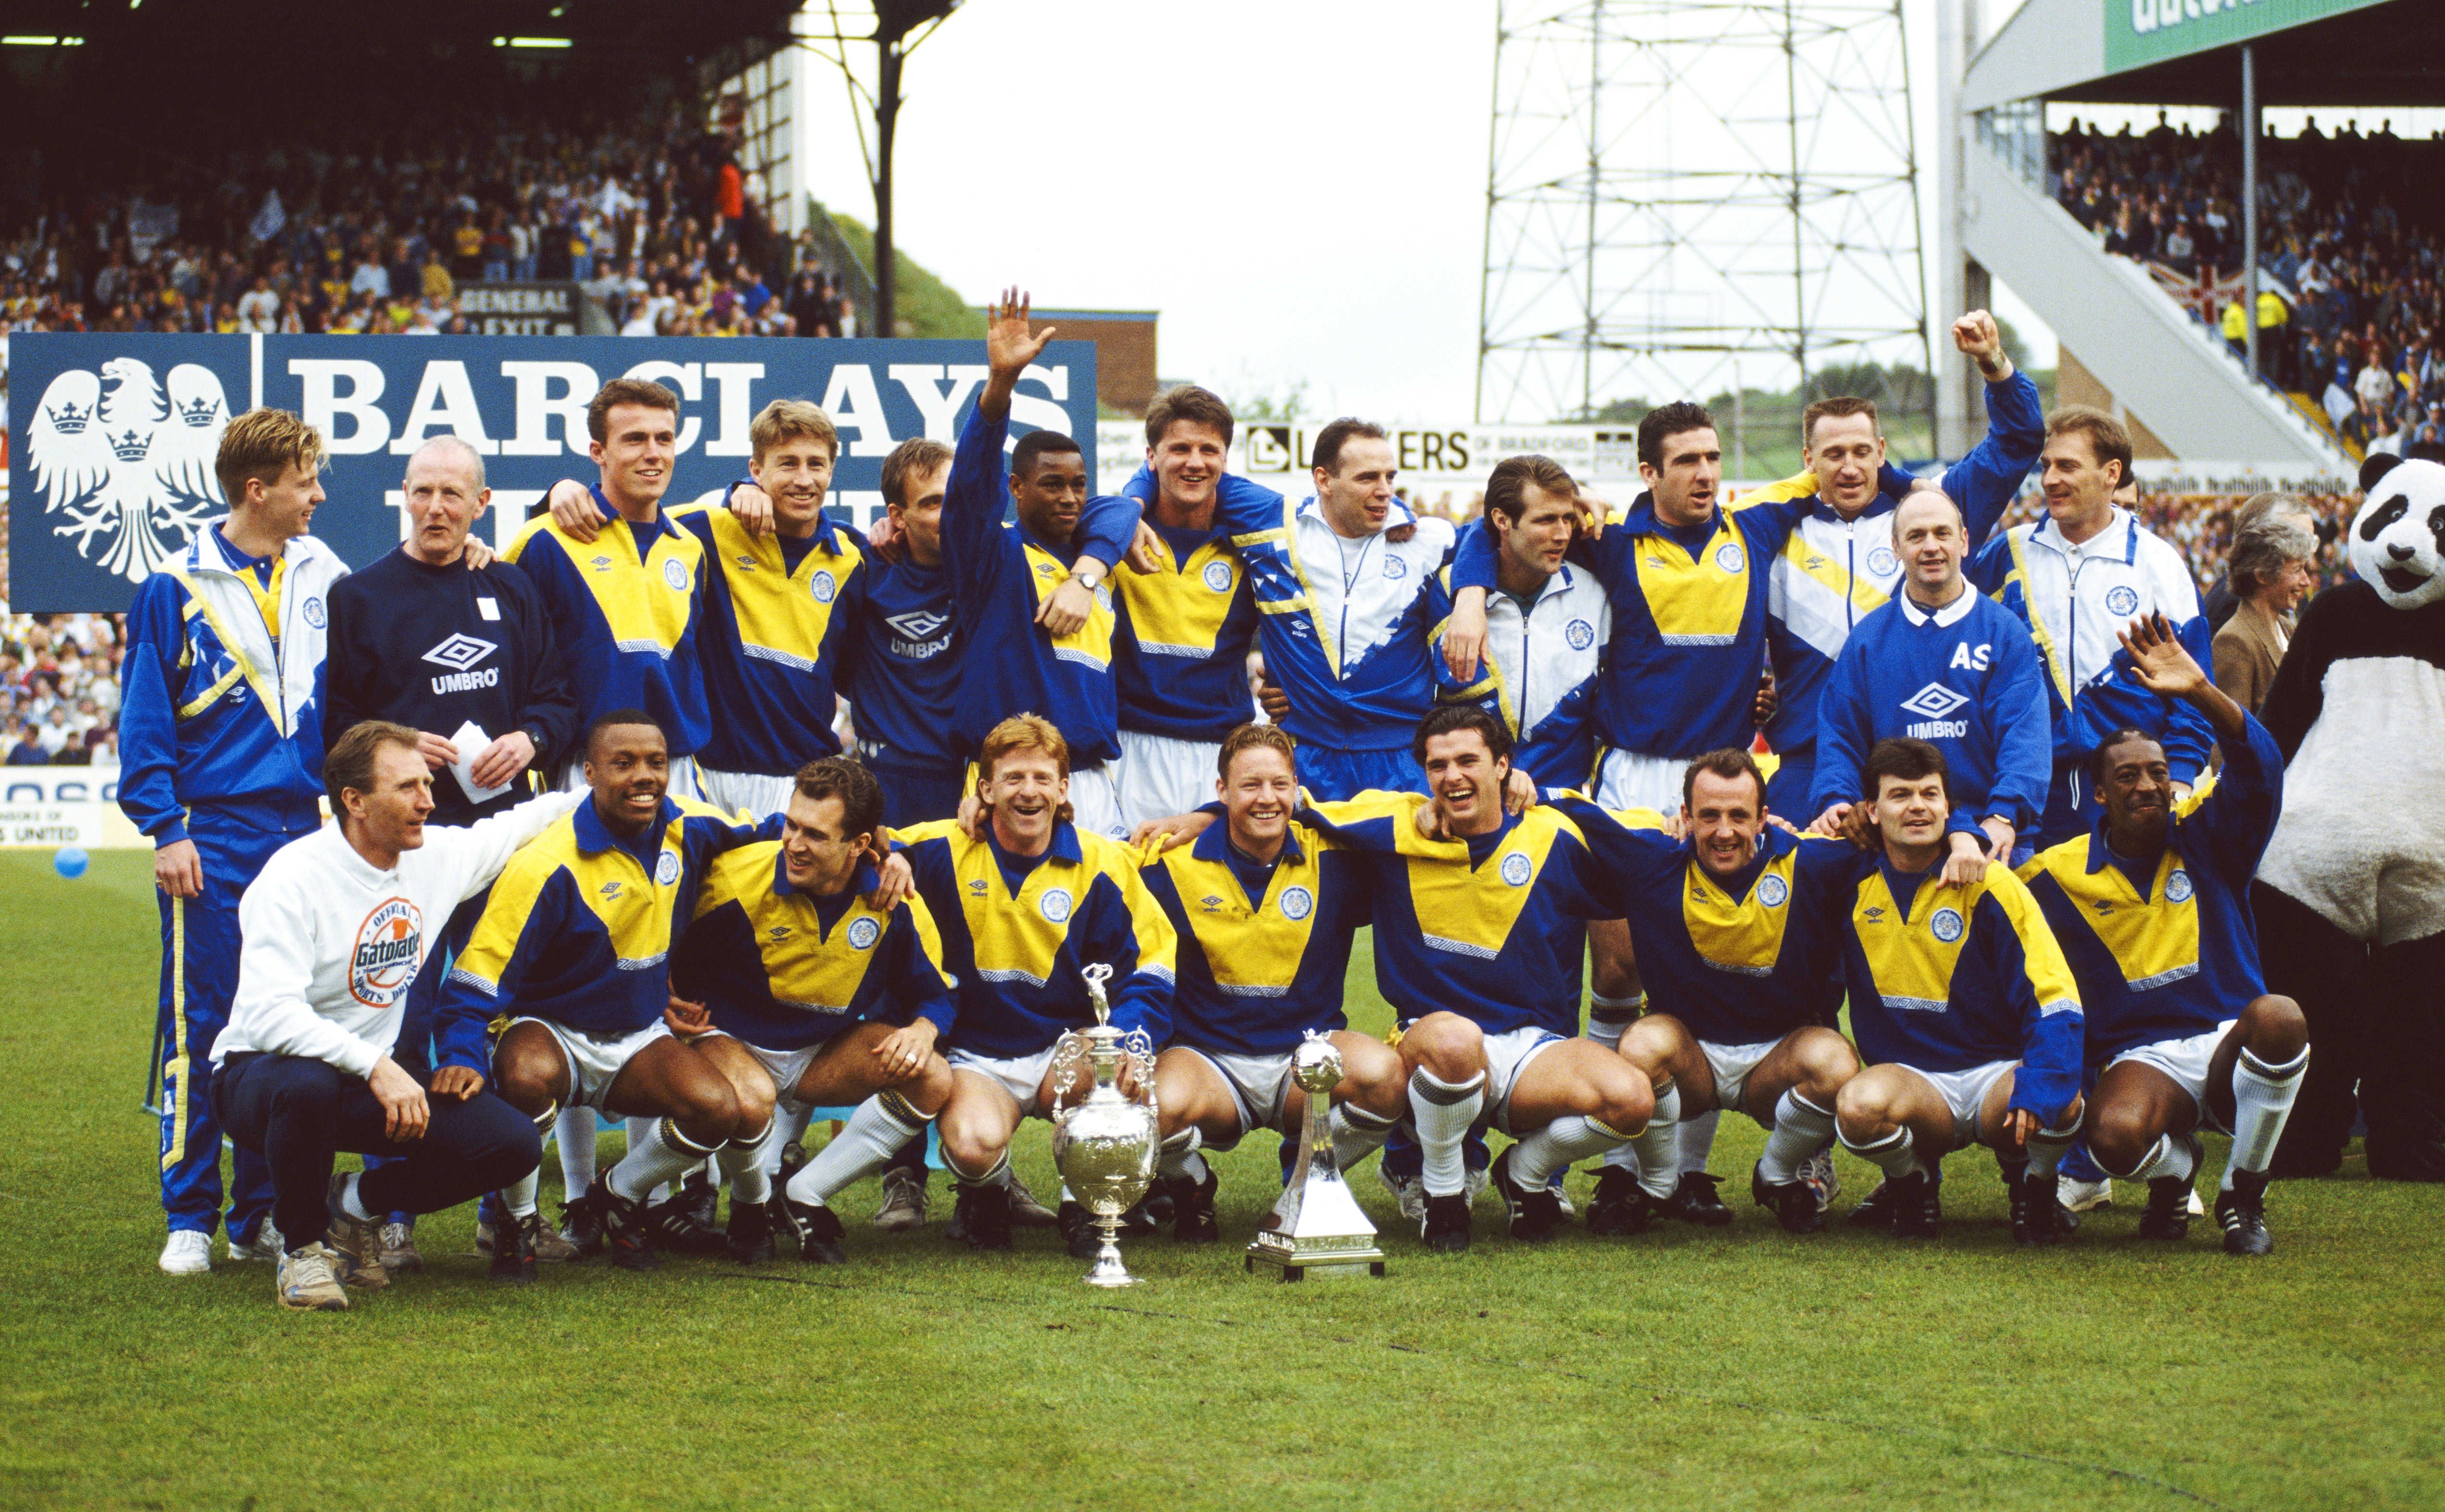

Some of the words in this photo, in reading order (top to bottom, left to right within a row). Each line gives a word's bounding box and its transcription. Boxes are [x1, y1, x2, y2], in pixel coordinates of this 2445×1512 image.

[484, 318, 549, 335] EXIT
[1498, 436, 1587, 453] BRADFORD
[891, 635, 950, 659] UMBRO
[1949, 641, 1992, 671] AS
[431, 668, 499, 695] UMBRO
[1907, 720, 1966, 740] UMBRO
[15, 827, 79, 842] UNITED
[355, 930, 420, 967] Gatorade
[354, 976, 384, 1003] SPORTS
